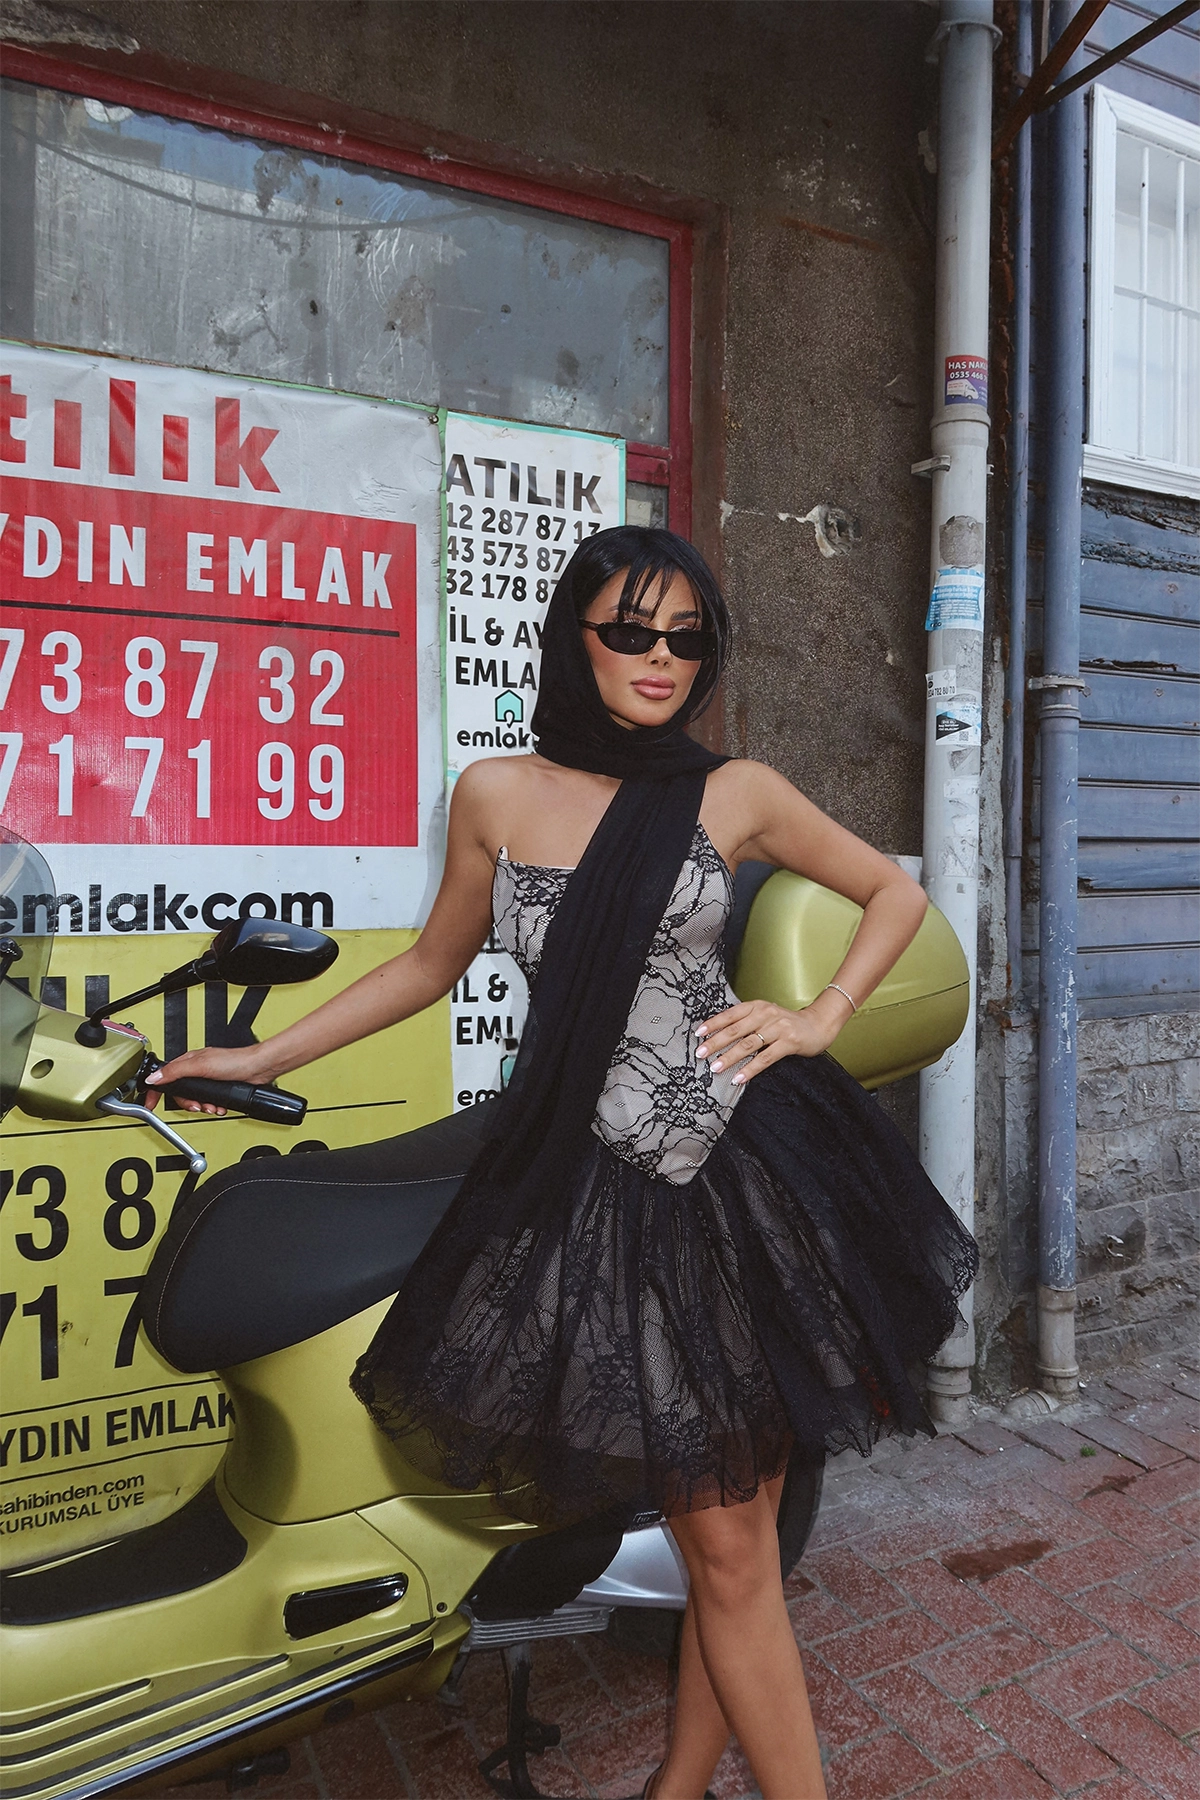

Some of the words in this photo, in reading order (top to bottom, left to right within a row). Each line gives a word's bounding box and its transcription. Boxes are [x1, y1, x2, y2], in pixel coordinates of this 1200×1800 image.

[948, 361, 967, 369] HAS
[949, 371, 970, 379] 0535
[481, 506, 529, 536] 287
[535, 514, 566, 542] 87
[186, 532, 393, 609] EMLAK
[447, 535, 475, 563] 43
[483, 540, 529, 569] 573
[536, 546, 567, 574] 87
[446, 568, 474, 597] 32
[481, 572, 527, 602] 178
[535, 578, 560, 604] 8
[484, 617, 505, 647] &
[124, 635, 219, 720] 87
[257, 645, 345, 727] 32
[455, 655, 538, 691] EMLA
[456, 726, 531, 748] emlak
[124, 736, 212, 819] 71
[257, 741, 345, 822] 99
[487, 973, 509, 1003] &
[0, 1164, 70, 1262] 3
[103, 1152, 206, 1251] 87
[106, 1392, 236, 1447] EMLAK
[107, 1491, 145, 1512] ÜYE
